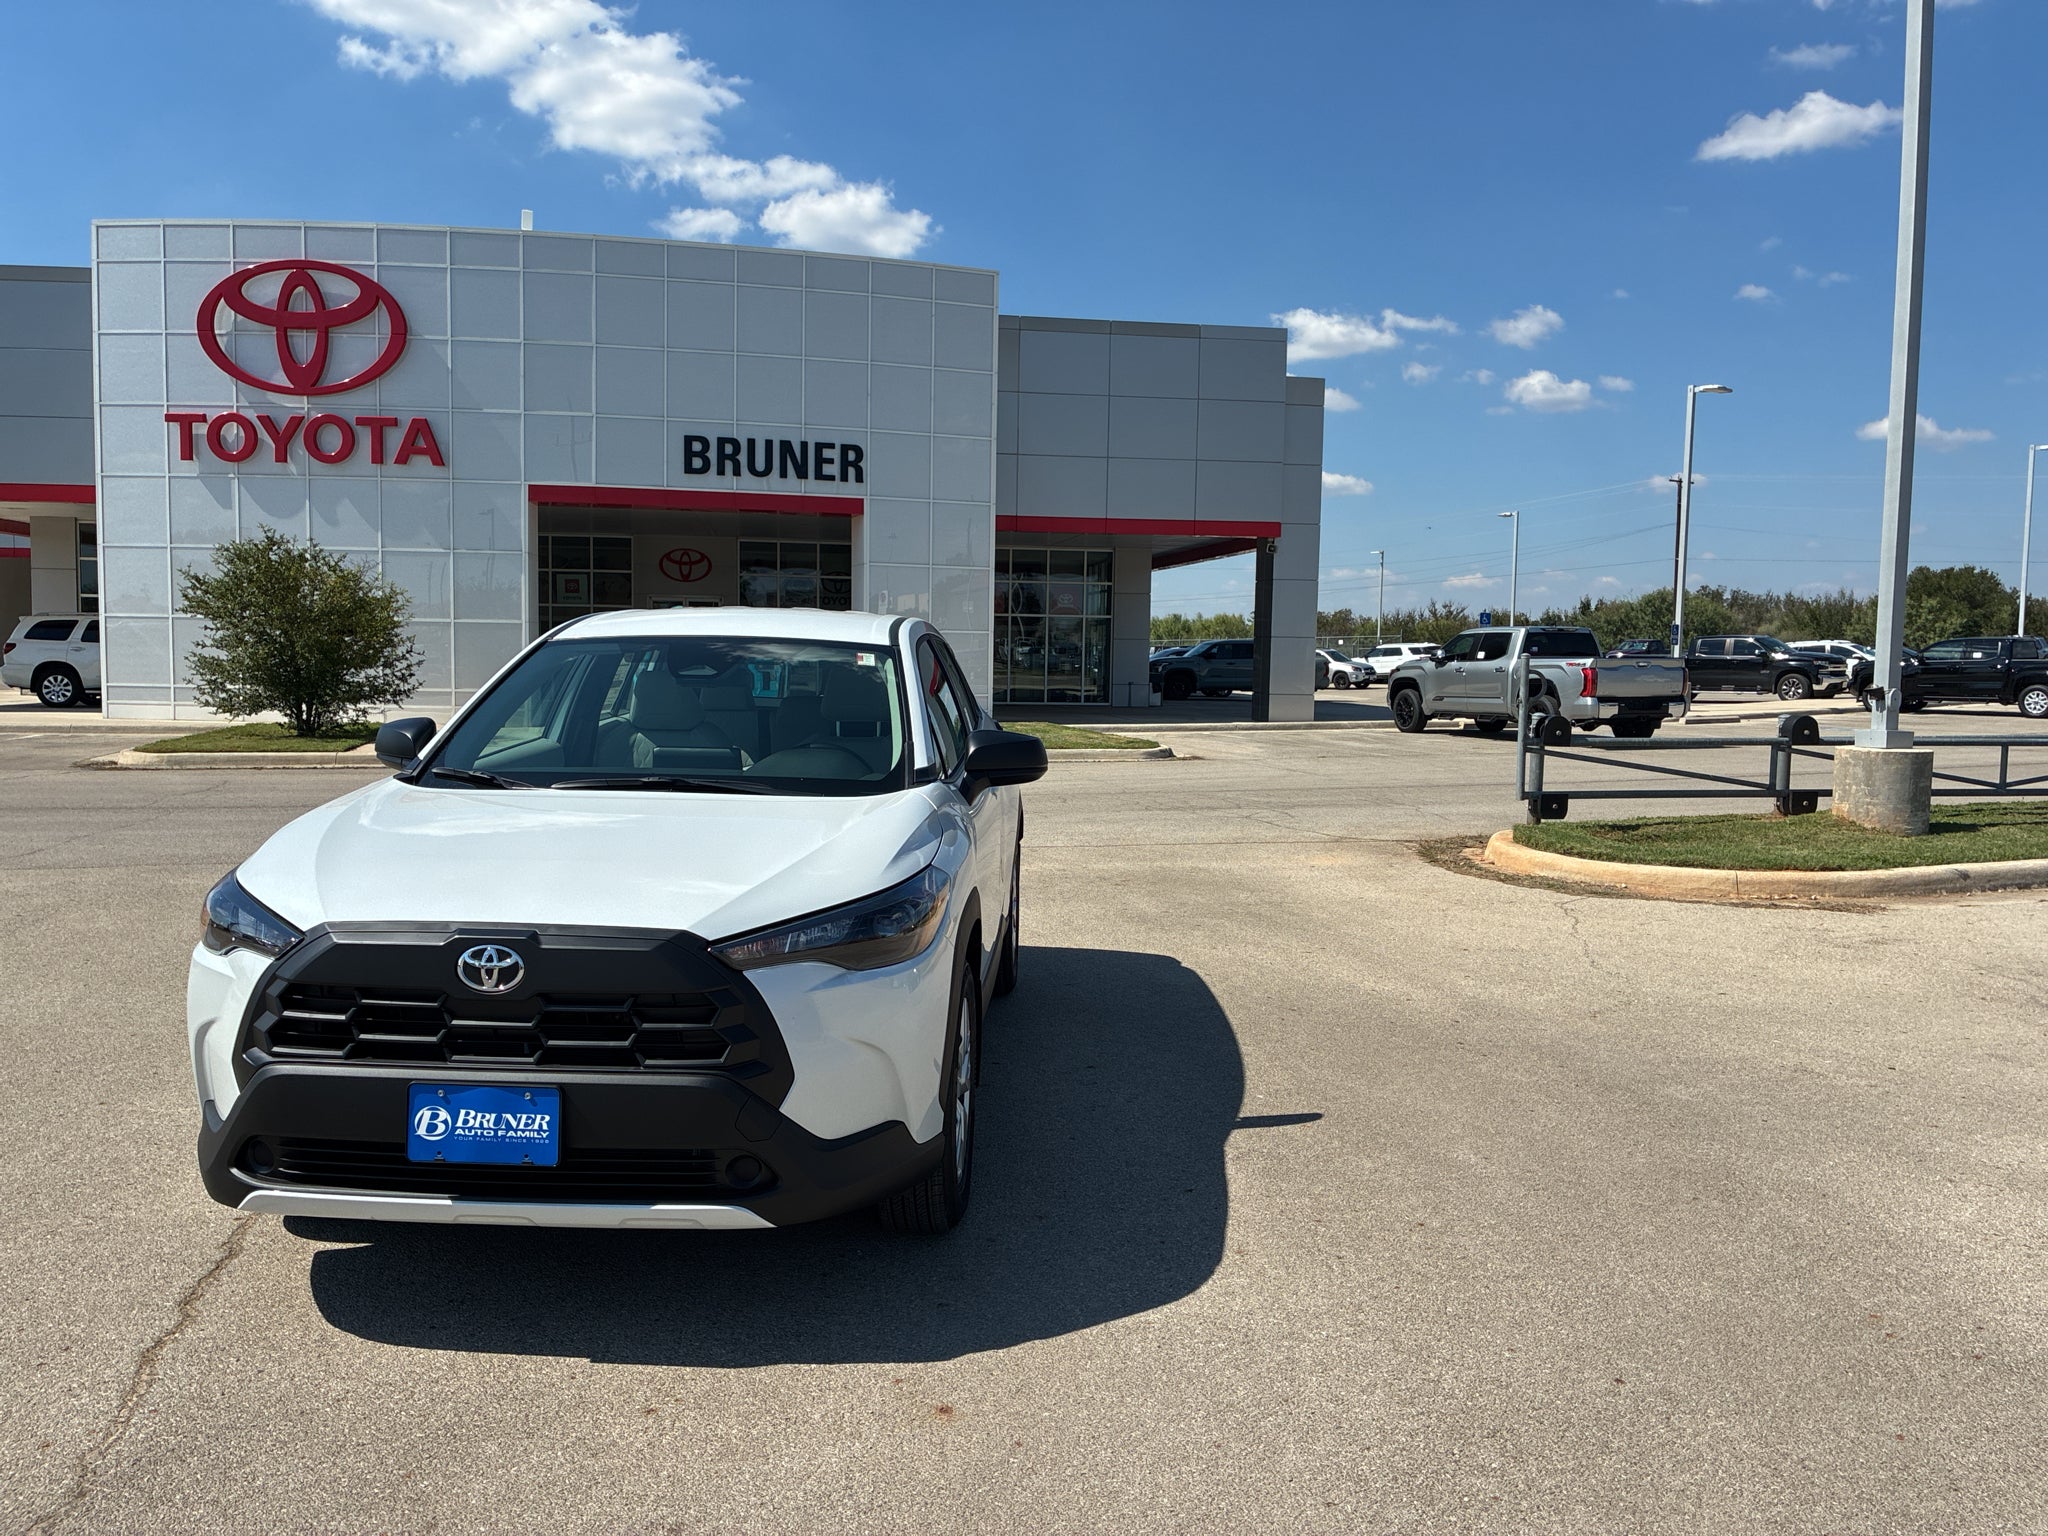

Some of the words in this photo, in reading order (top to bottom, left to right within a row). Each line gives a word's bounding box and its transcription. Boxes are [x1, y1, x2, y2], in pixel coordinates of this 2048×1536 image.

[164, 411, 445, 467] TOYOTA
[683, 434, 864, 483] BRUNER
[455, 1109, 550, 1130] BRUNER
[498, 1130, 549, 1138] FAMILY
